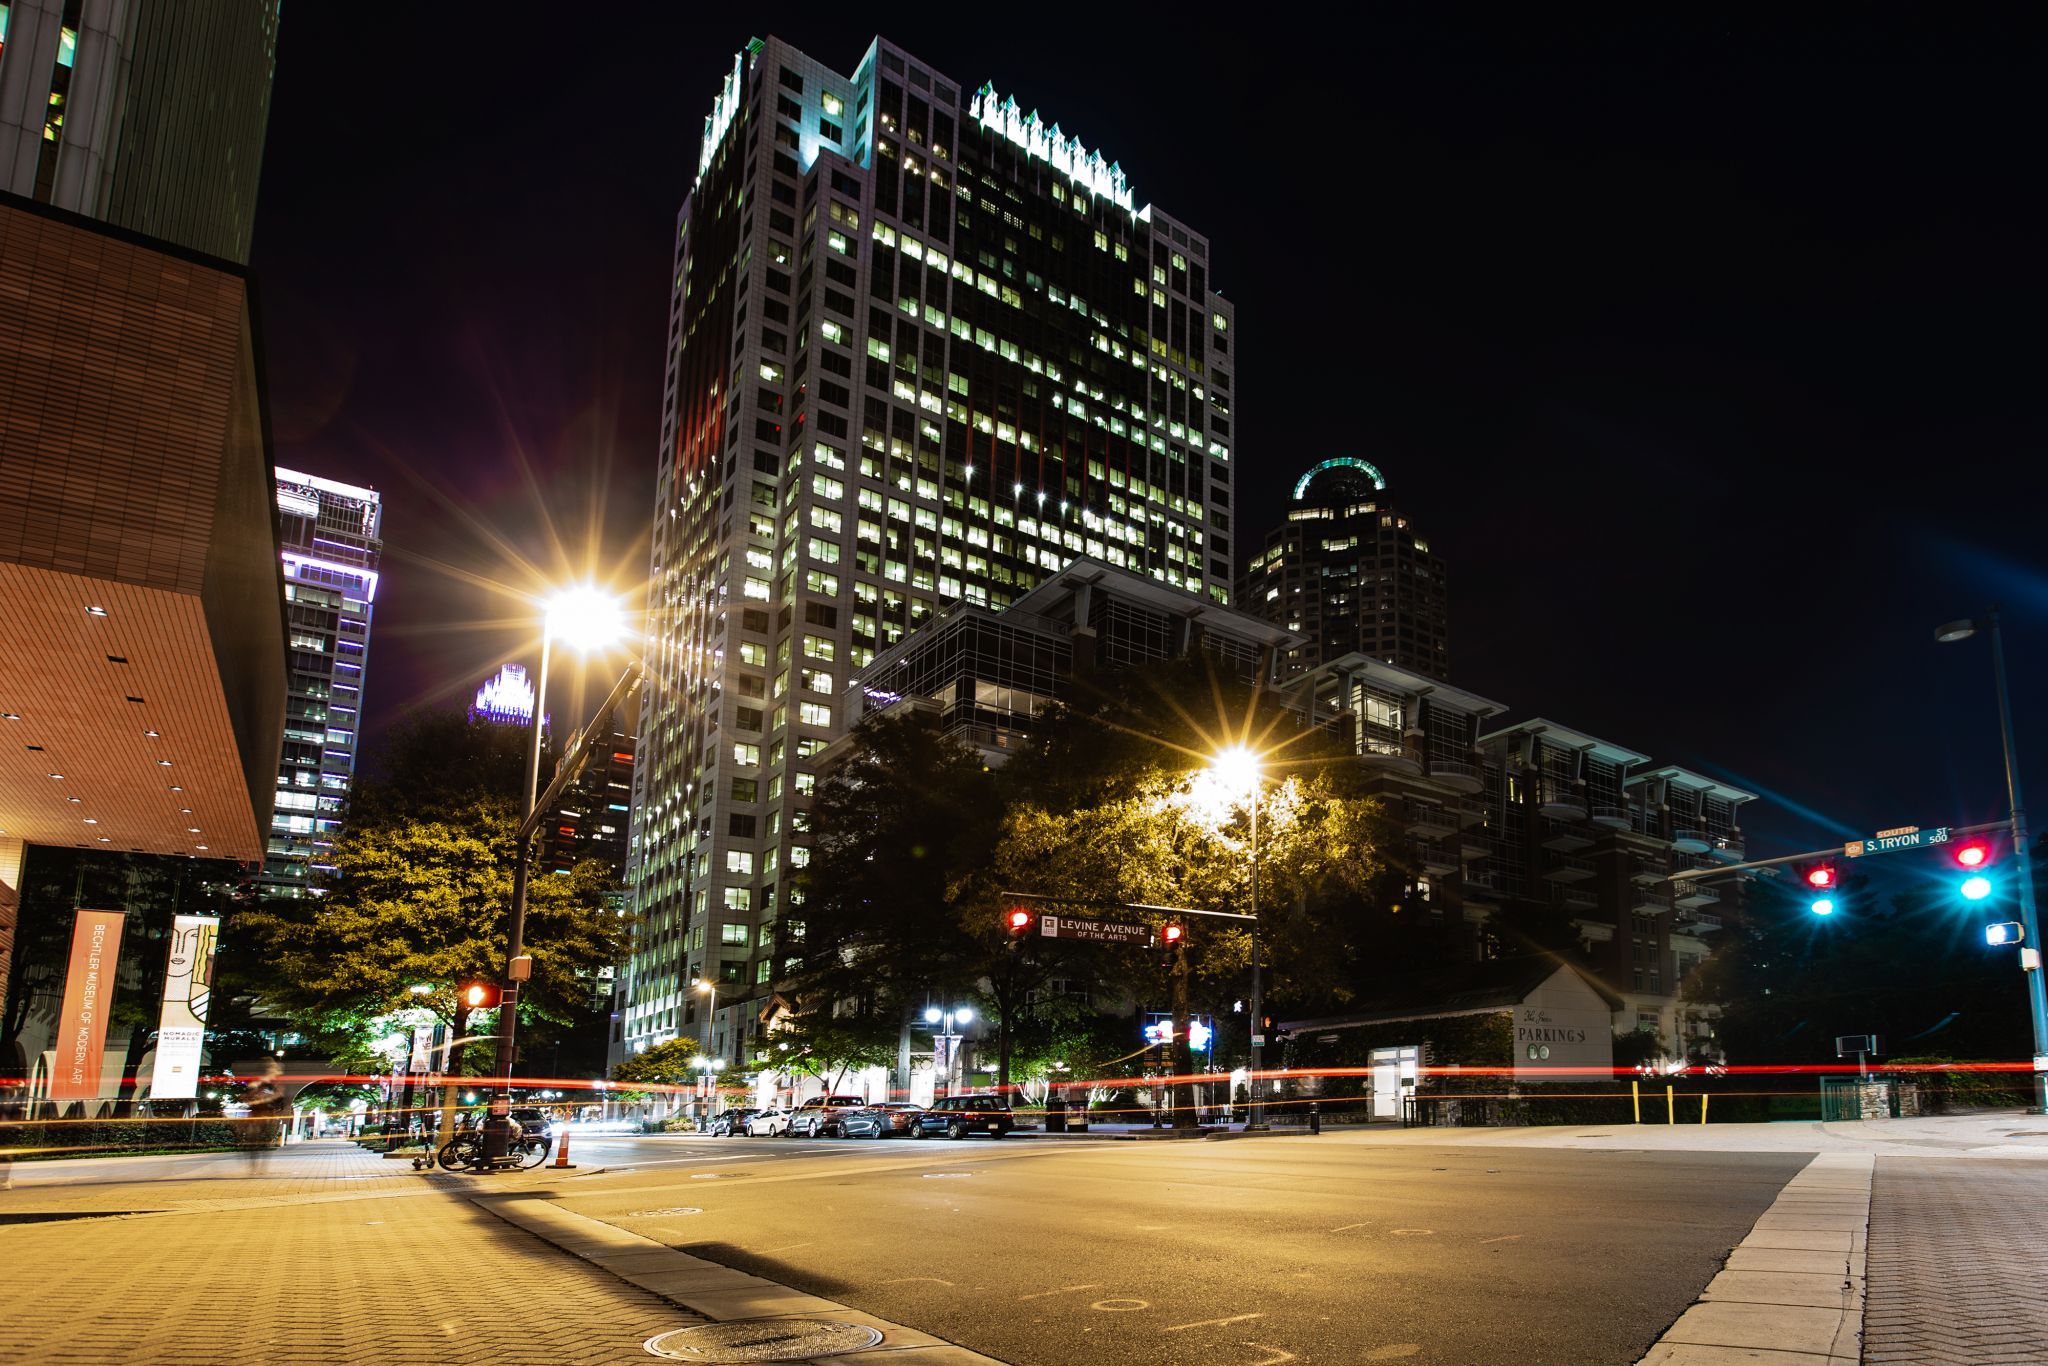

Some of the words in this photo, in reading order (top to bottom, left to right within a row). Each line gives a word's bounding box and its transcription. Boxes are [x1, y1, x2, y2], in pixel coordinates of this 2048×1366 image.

[1867, 841, 1878, 851] S.
[1879, 834, 1920, 849] TRYON
[1929, 835, 1948, 844] 500
[1060, 920, 1099, 931] LEVINE
[1103, 924, 1145, 935] AVENUE
[1108, 933, 1127, 941] ARTS
[88, 924, 105, 970] BECHTLER
[83, 972, 98, 1010] MUSEUM
[80, 1011, 92, 1024] OF
[1519, 1028, 1574, 1042] PARKING
[74, 1027, 89, 1065] MODERN
[71, 1067, 83, 1085] ART
